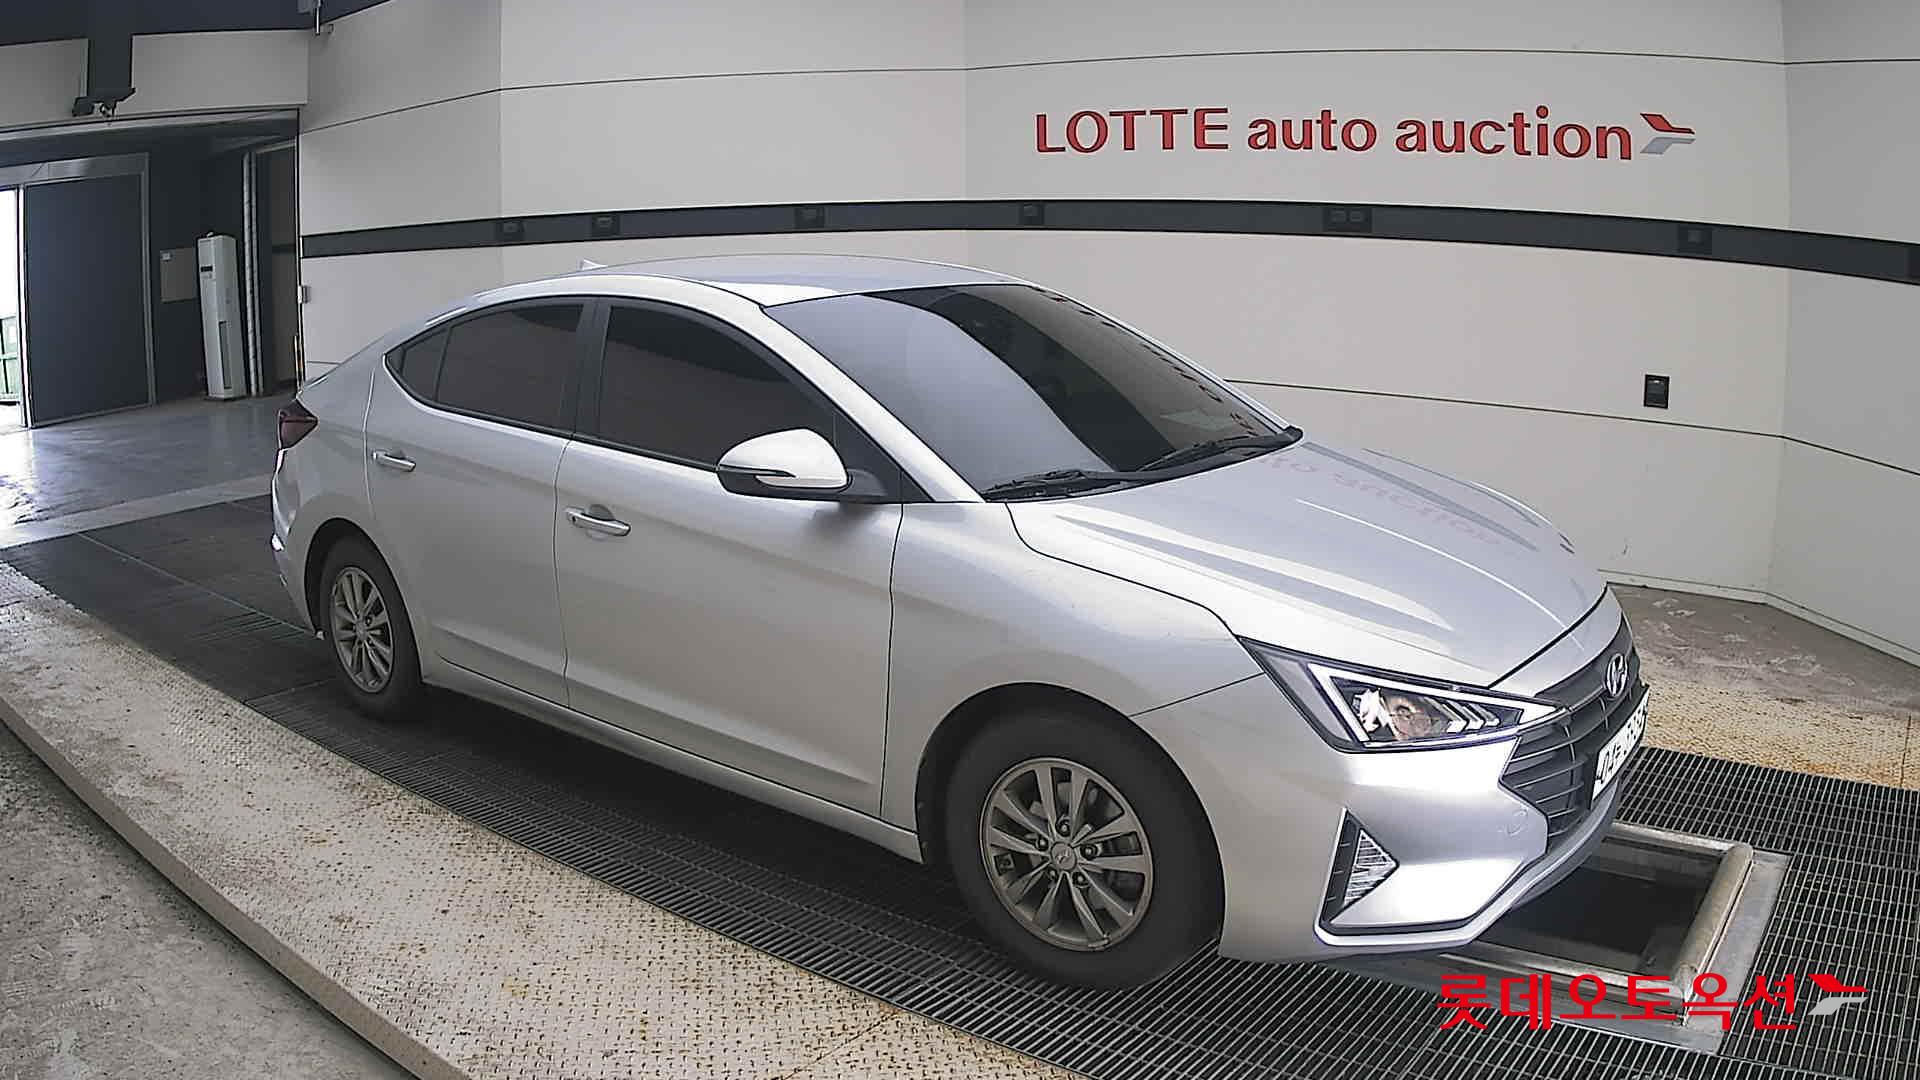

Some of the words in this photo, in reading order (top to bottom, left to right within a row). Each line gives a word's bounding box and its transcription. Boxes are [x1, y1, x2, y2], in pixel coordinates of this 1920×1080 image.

[1035, 107, 1229, 153] LOTTE
[1247, 109, 1377, 152] auto
[1395, 105, 1632, 160] auction
